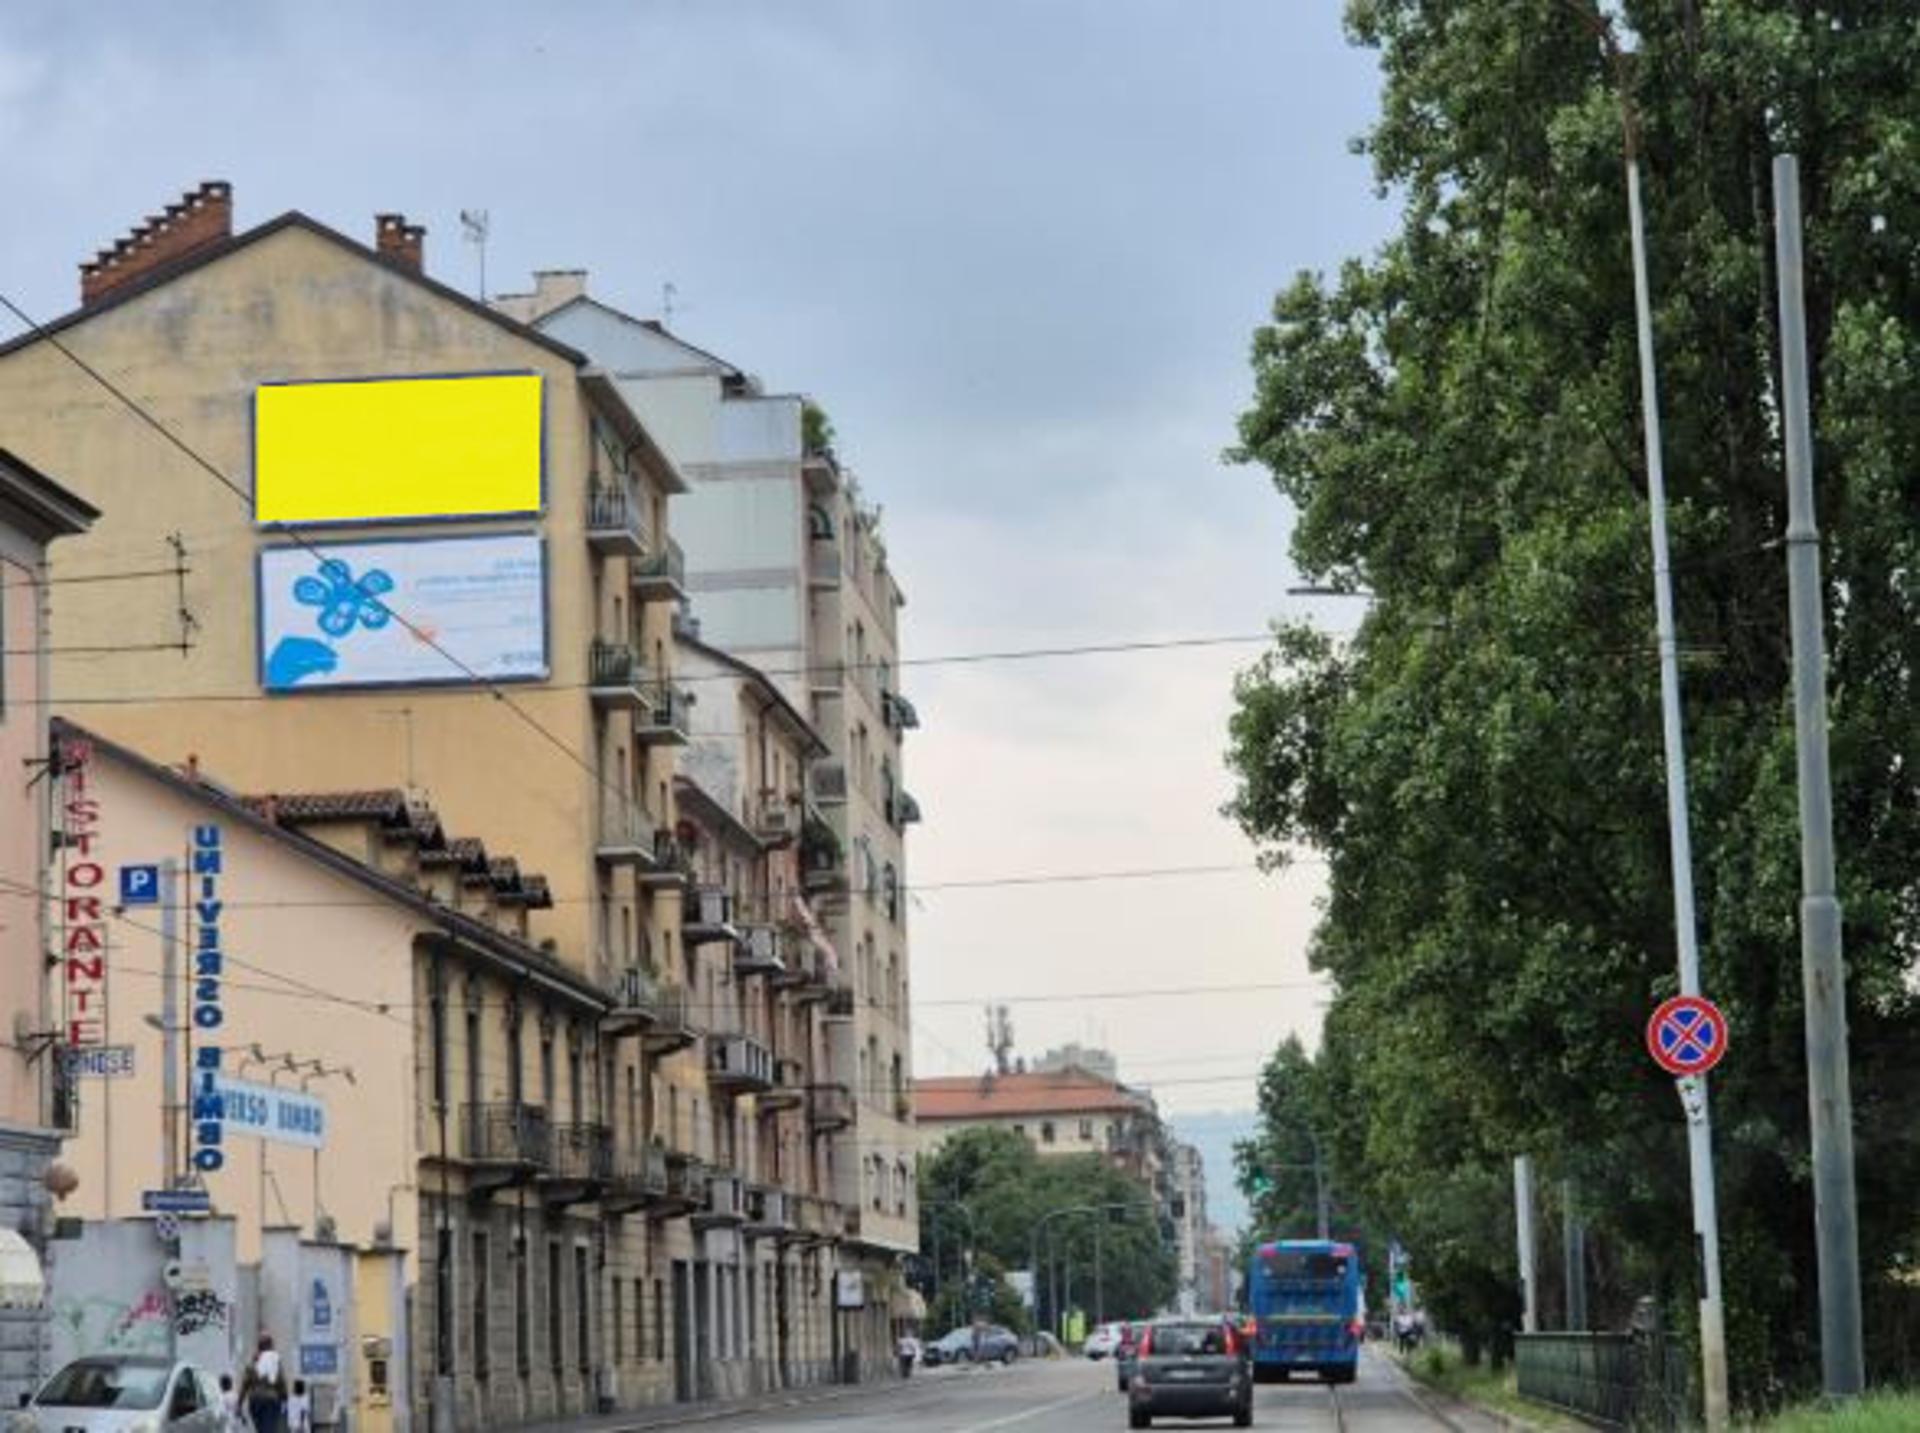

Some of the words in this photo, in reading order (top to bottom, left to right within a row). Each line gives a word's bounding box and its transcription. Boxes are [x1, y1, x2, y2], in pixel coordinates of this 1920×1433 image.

[65, 741, 104, 1047] RISTORANTE
[130, 869, 149, 892] P
[194, 826, 223, 1029] UNIVERSO
